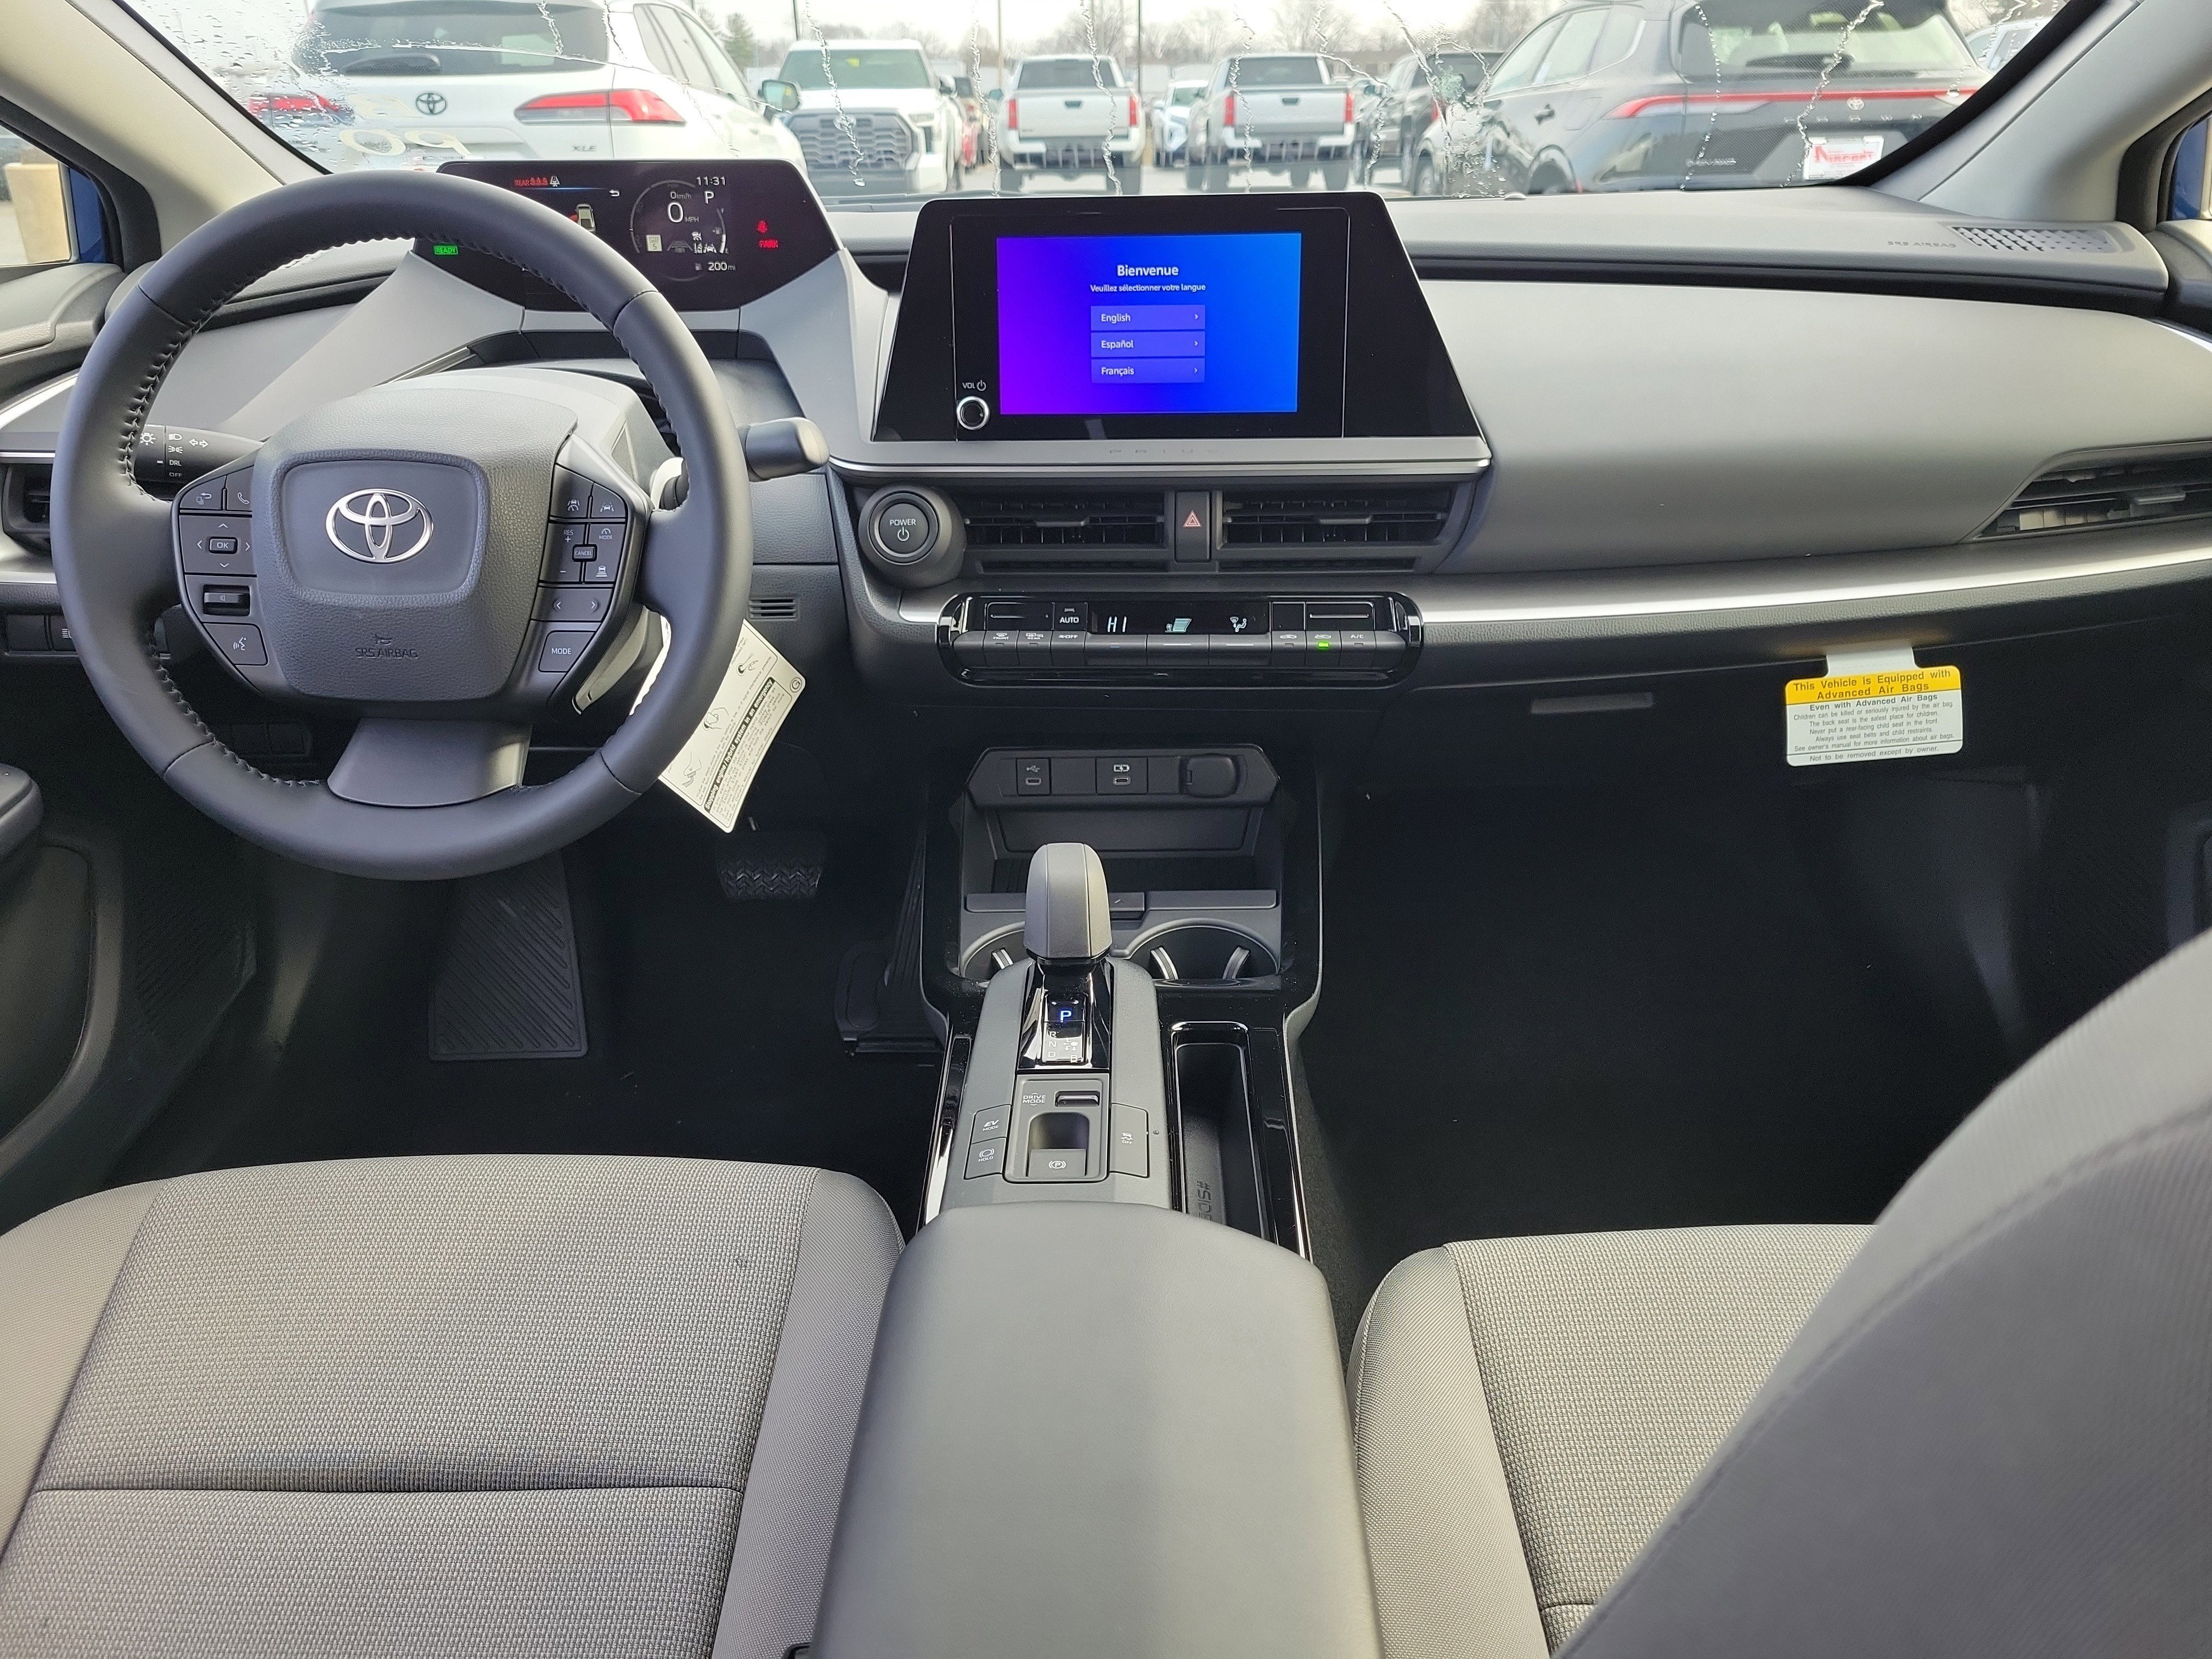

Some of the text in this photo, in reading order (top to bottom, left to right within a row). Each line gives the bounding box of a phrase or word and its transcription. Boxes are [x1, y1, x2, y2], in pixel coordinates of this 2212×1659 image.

[696, 176, 726, 186] 11:31
[704, 191, 714, 204] P
[667, 202, 684, 223] 0
[1117, 264, 1179, 276] Bienvenue
[1090, 284, 1118, 292] Veuillez
[1119, 284, 1161, 292] sélectionner
[1181, 283, 1206, 292] langue
[1101, 313, 1131, 324] English
[1101, 338, 1134, 350] Español
[1101, 365, 1135, 377] Français
[355, 648, 418, 658] SRS AIRBAG
[790, 679, 802, 691] G
[1793, 669, 1951, 691] This Vehicle is Equipped with
[753, 678, 775, 709] emergency
[1817, 683, 1929, 700] Advanced Air Bags
[1856, 697, 1896, 707] Advanced
[747, 707, 757, 718] an
[1866, 705, 1888, 714] seriously
[1892, 703, 1909, 712] injured
[743, 716, 752, 724] in
[733, 723, 748, 745] system
[703, 783, 719, 809] Stopping
[1060, 1011, 1071, 1022] P
[1070, 1054, 1077, 1063] B
[984, 1119, 1000, 1127] EV
